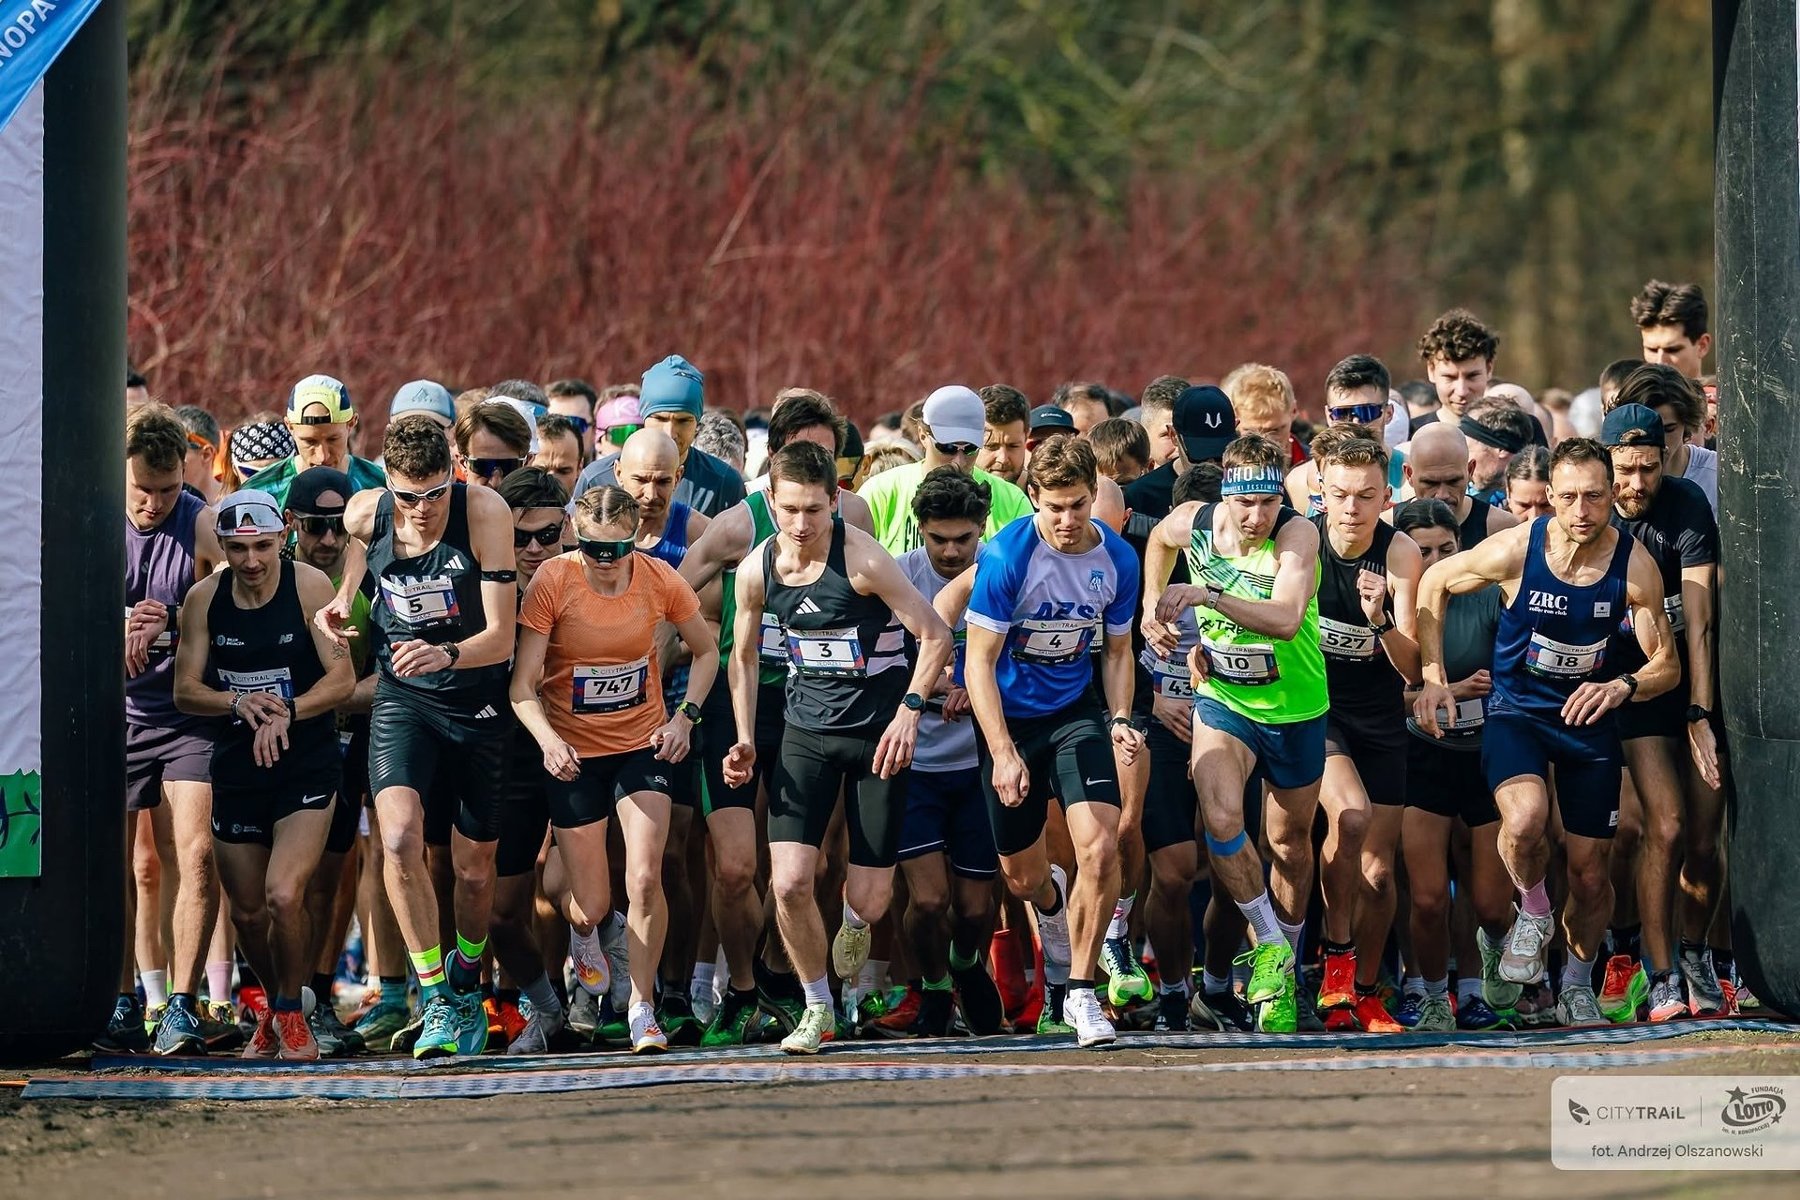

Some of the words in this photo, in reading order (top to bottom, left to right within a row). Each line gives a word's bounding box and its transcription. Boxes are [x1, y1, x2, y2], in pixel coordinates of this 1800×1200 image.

[409, 598, 424, 614] 5
[1528, 589, 1568, 611] ZRC
[1049, 634, 1062, 649] 4
[1326, 632, 1367, 650] 527
[818, 643, 833, 658] 3
[1223, 655, 1249, 670] 10
[1555, 655, 1578, 667] 18
[593, 675, 634, 696] 747
[1168, 679, 1193, 696] 43
